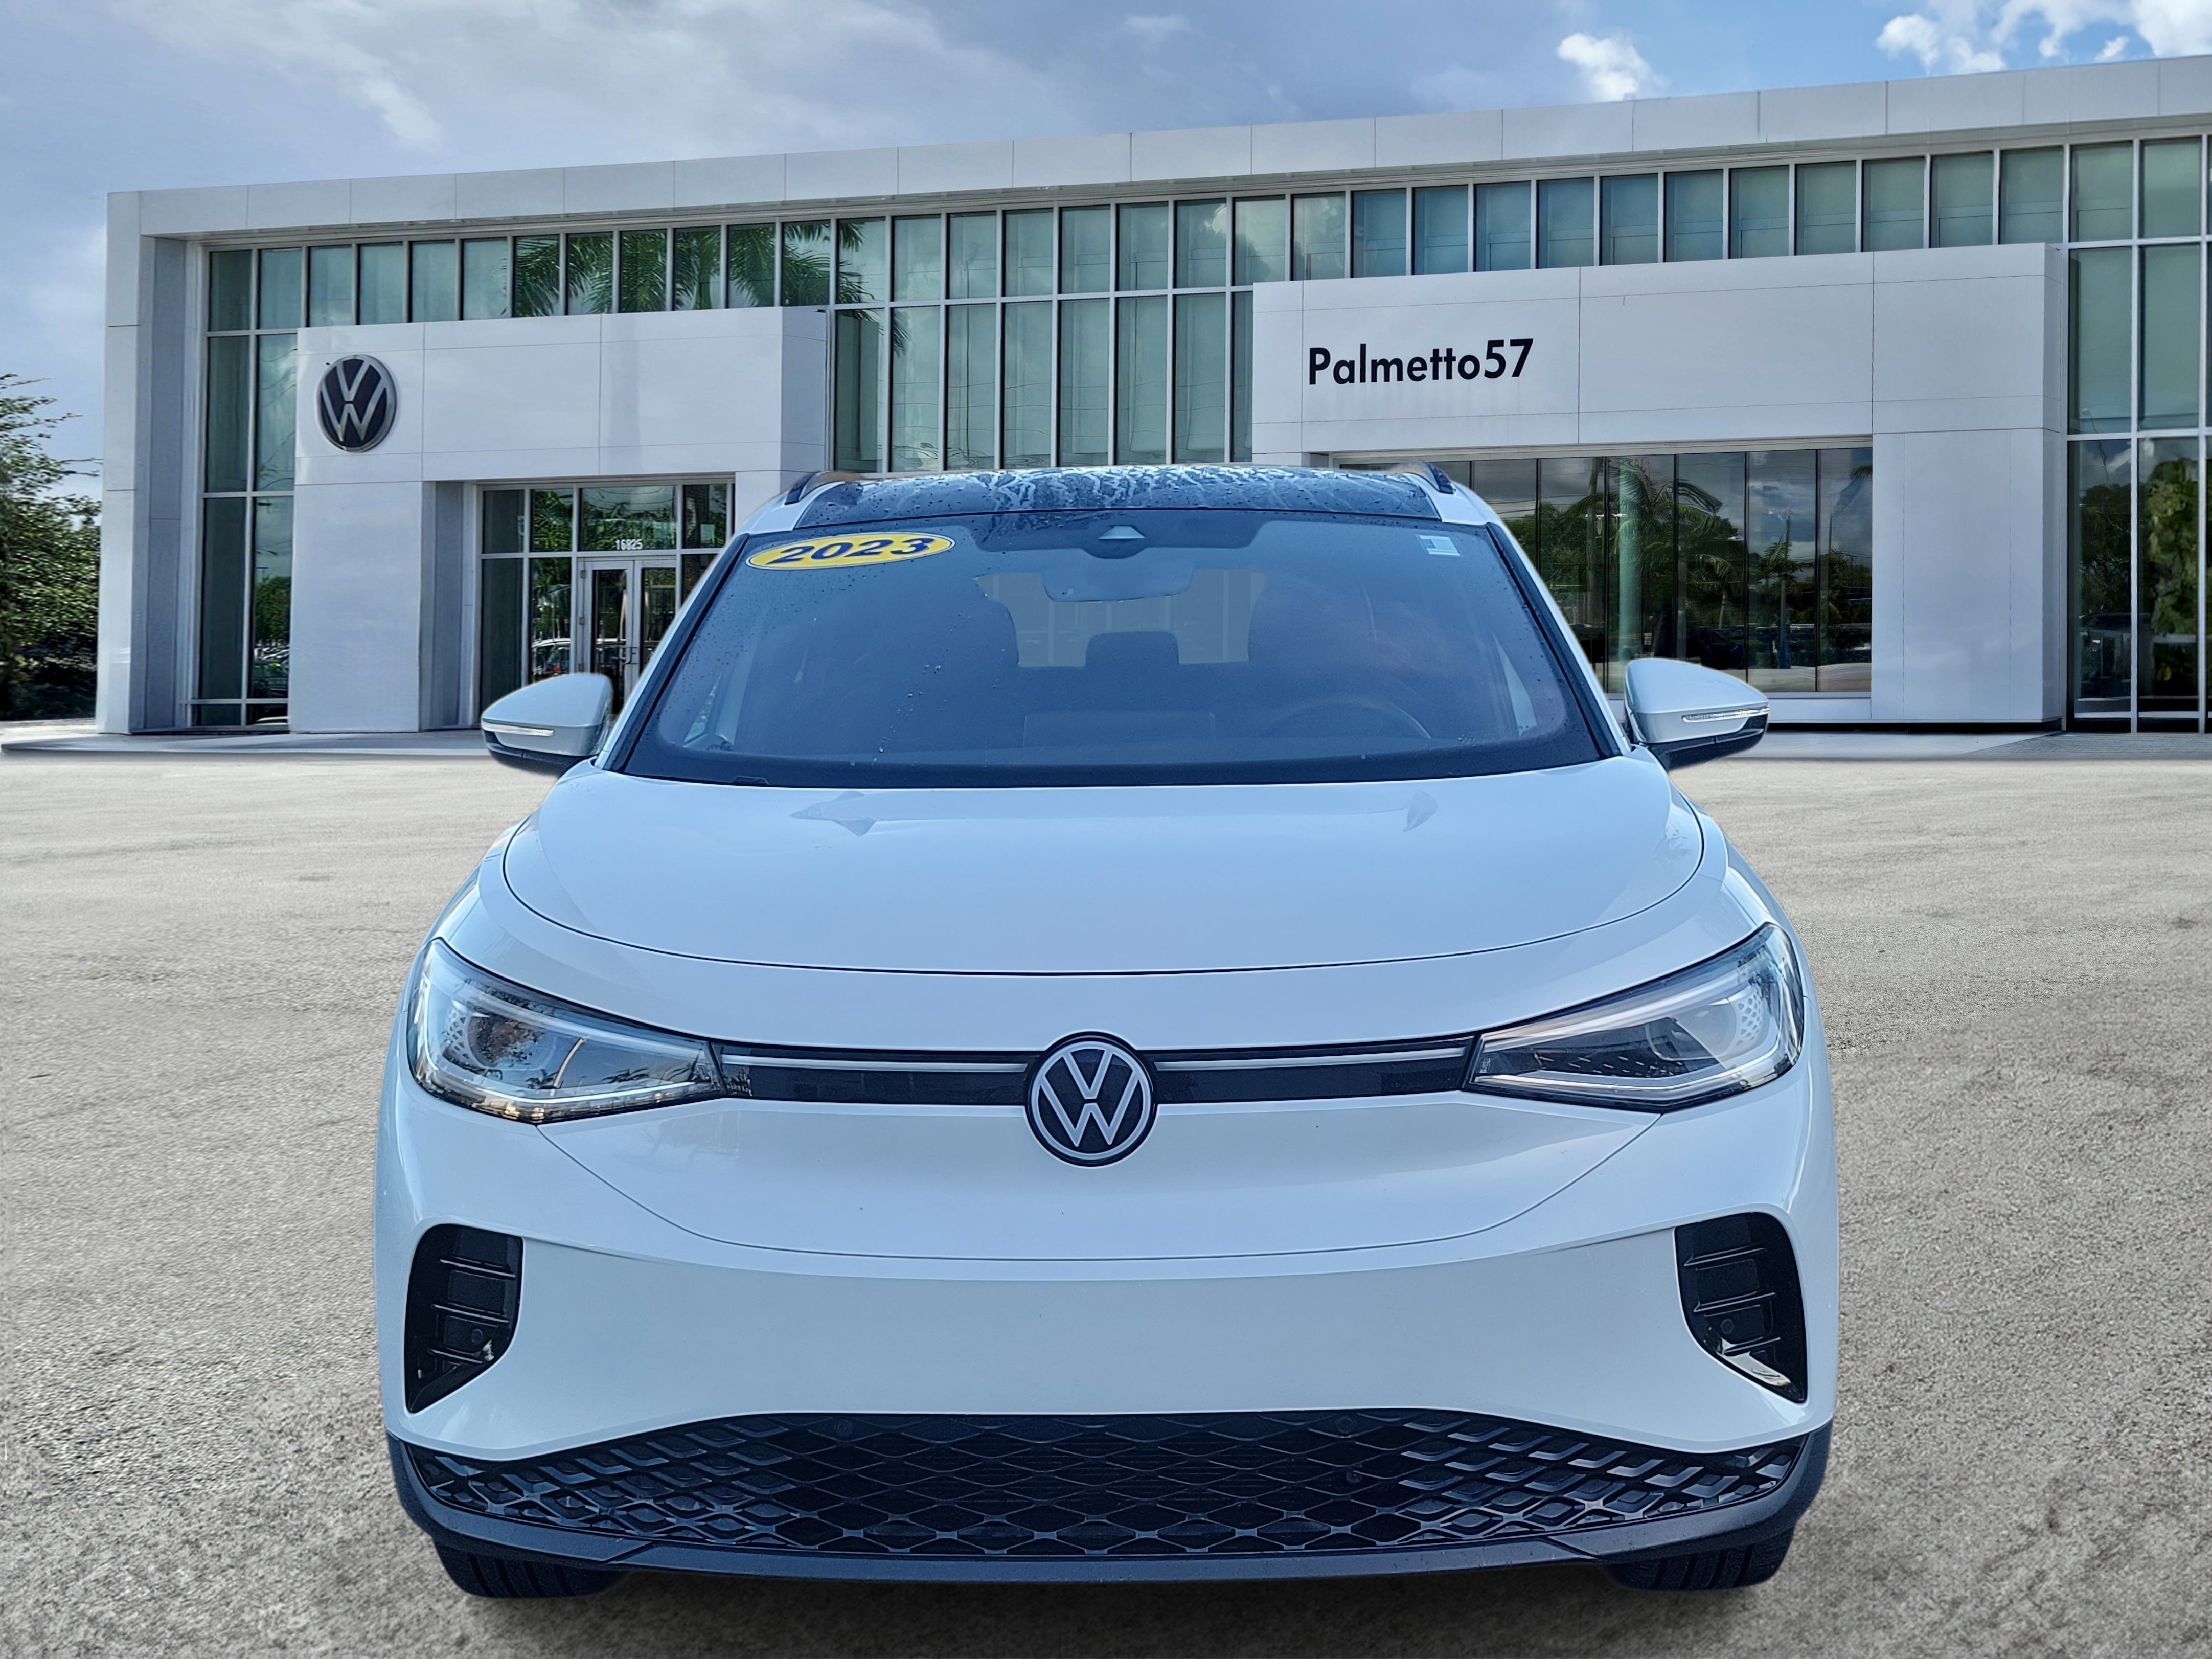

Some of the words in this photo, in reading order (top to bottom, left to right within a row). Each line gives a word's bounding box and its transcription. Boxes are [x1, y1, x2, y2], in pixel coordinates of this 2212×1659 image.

[1309, 338, 1534, 385] Palmetto57
[319, 358, 389, 443] VW
[615, 539, 643, 550] 16825
[765, 538, 935, 565] 2023
[1036, 1046, 1143, 1148] VW
